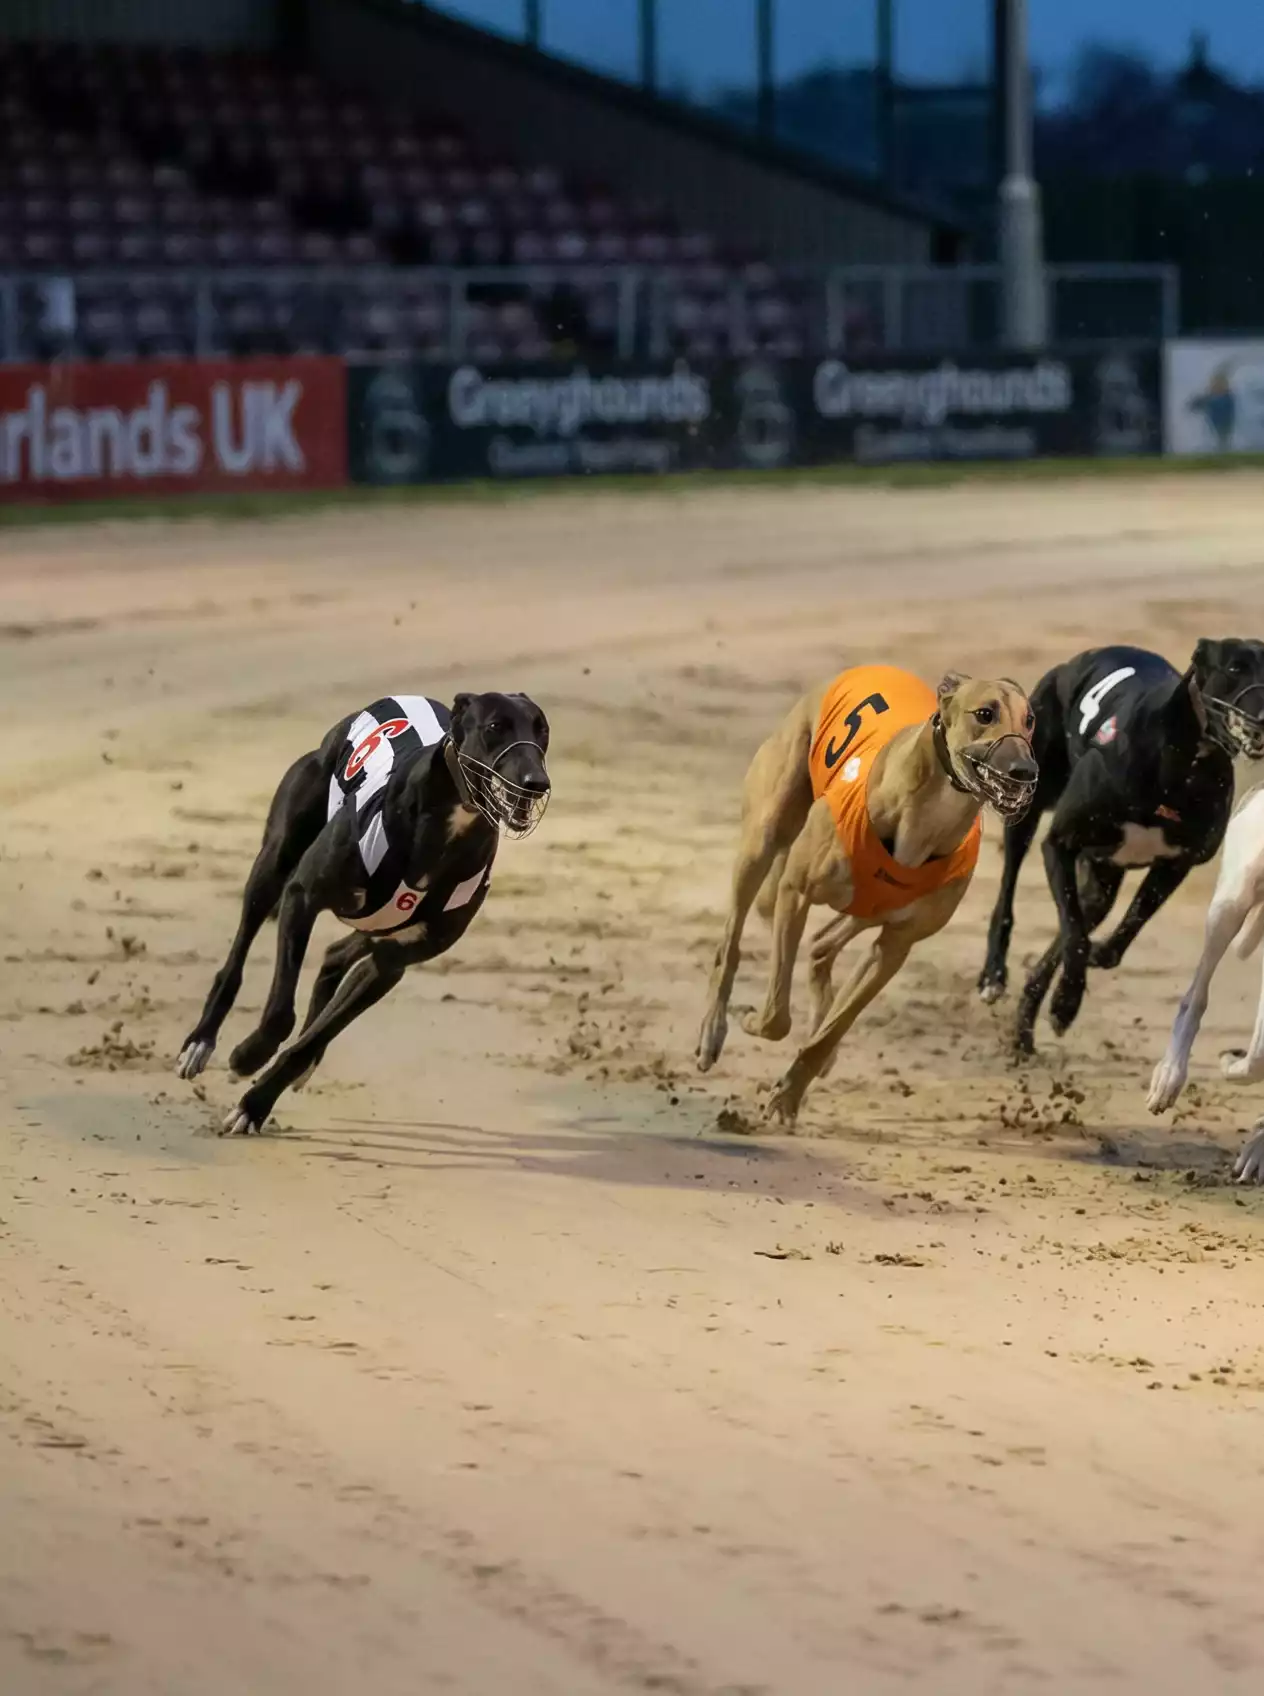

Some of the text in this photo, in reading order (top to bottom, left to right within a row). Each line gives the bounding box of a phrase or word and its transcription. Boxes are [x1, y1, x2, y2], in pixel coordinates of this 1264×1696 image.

[211, 378, 304, 473] UK
[825, 693, 890, 769] 5
[1078, 666, 1136, 735] 4
[344, 717, 414, 781] 6
[395, 891, 418, 911] 6
